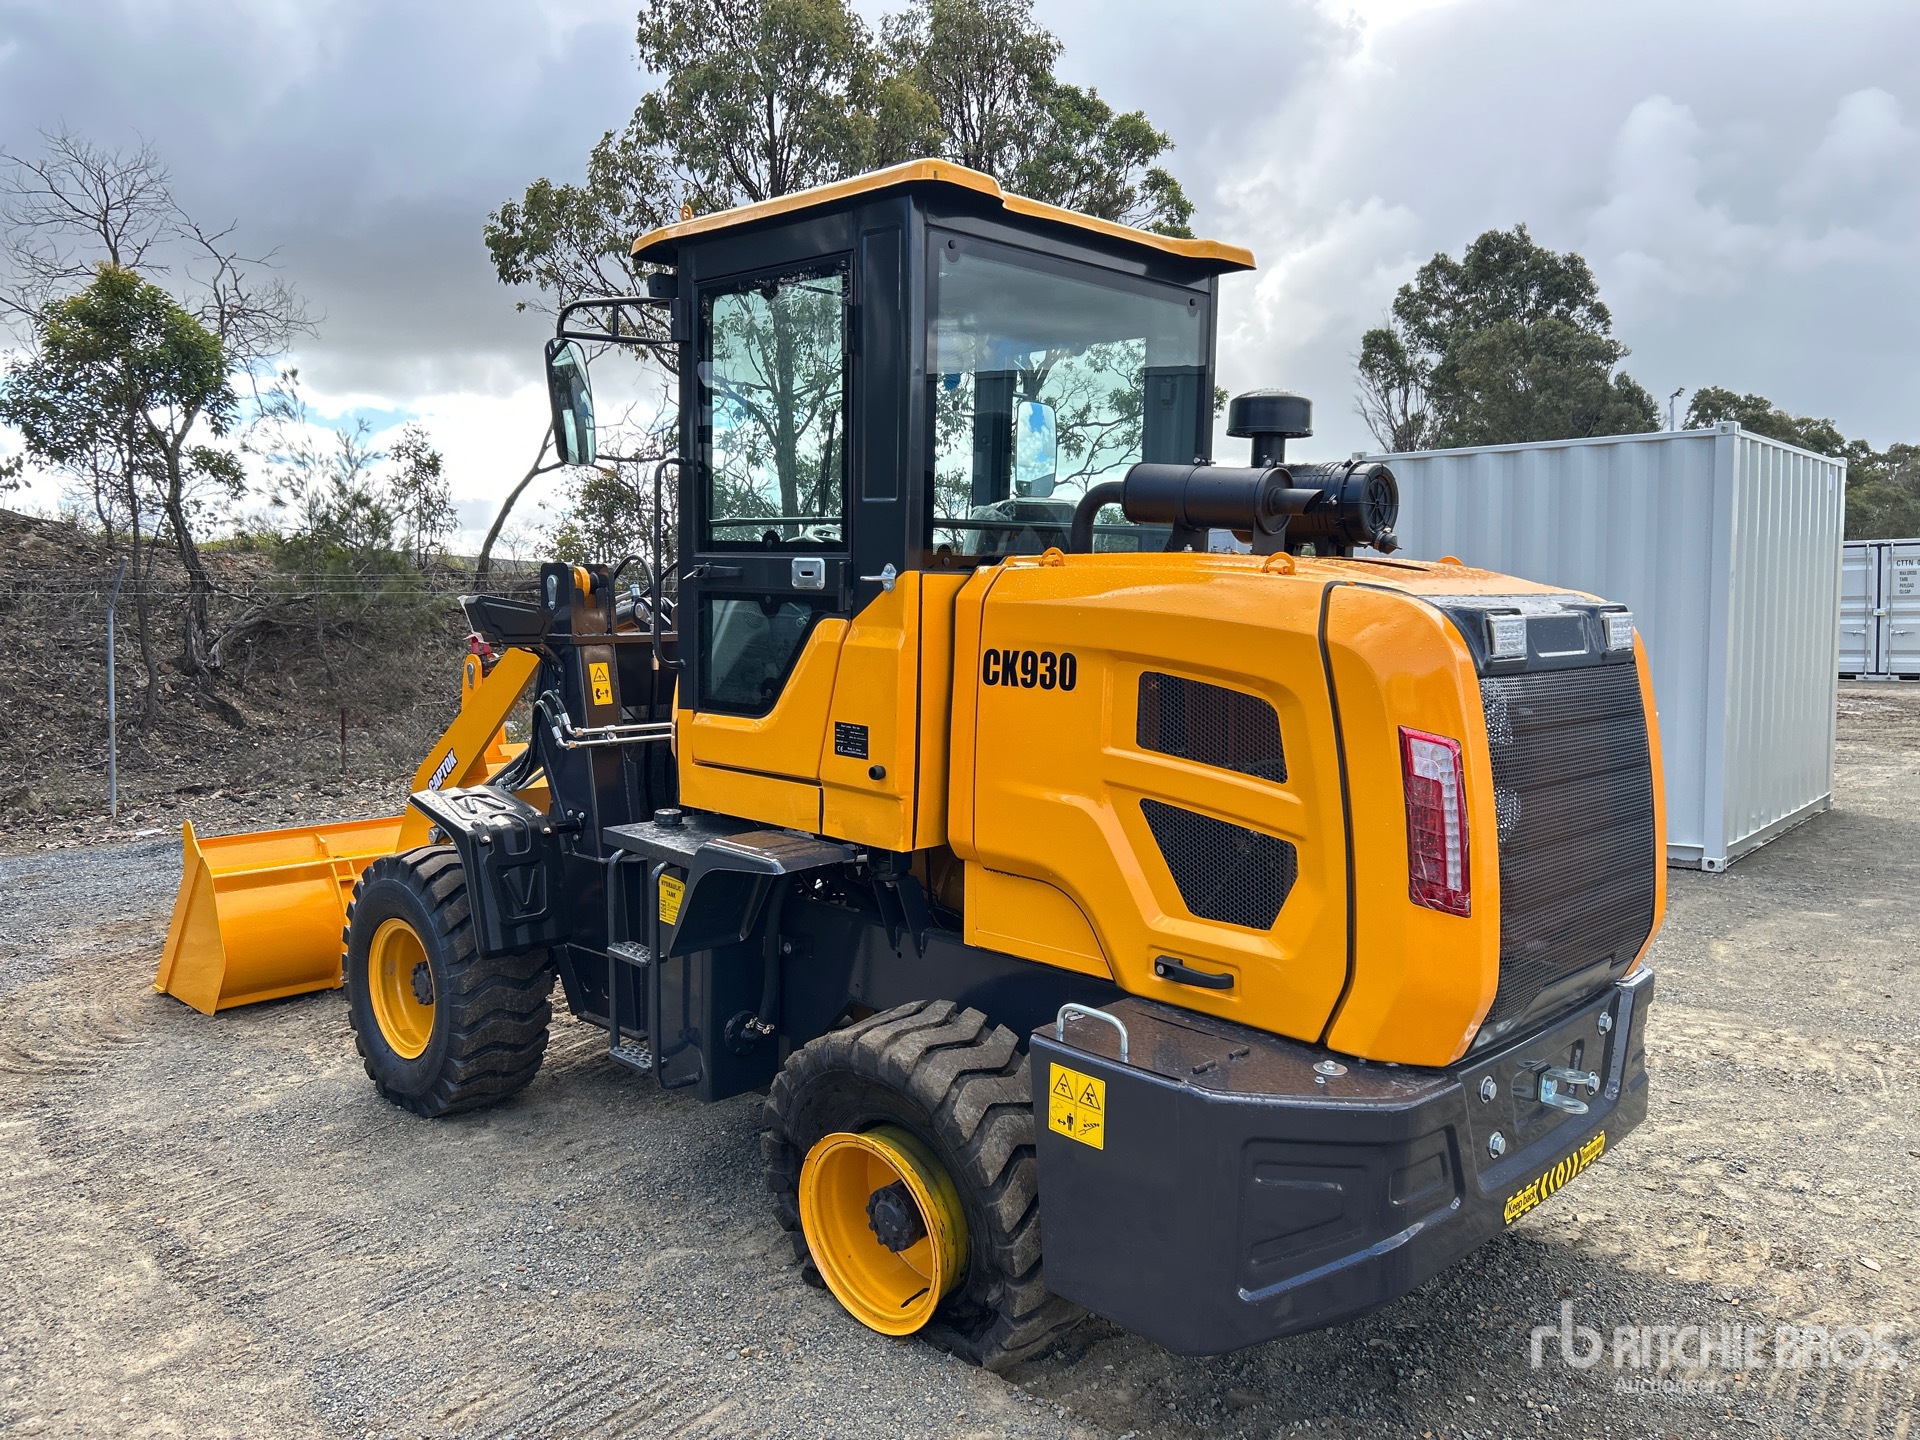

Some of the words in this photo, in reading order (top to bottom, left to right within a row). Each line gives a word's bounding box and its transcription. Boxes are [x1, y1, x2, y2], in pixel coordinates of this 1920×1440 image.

[1896, 559, 1914, 567] CTTN
[982, 648, 1077, 692] CK930
[660, 879, 682, 892] HYDRAULIC
[666, 889, 677, 899] TANK
[1508, 1199, 1523, 1215] Keep
[1523, 1189, 1536, 1205] back
